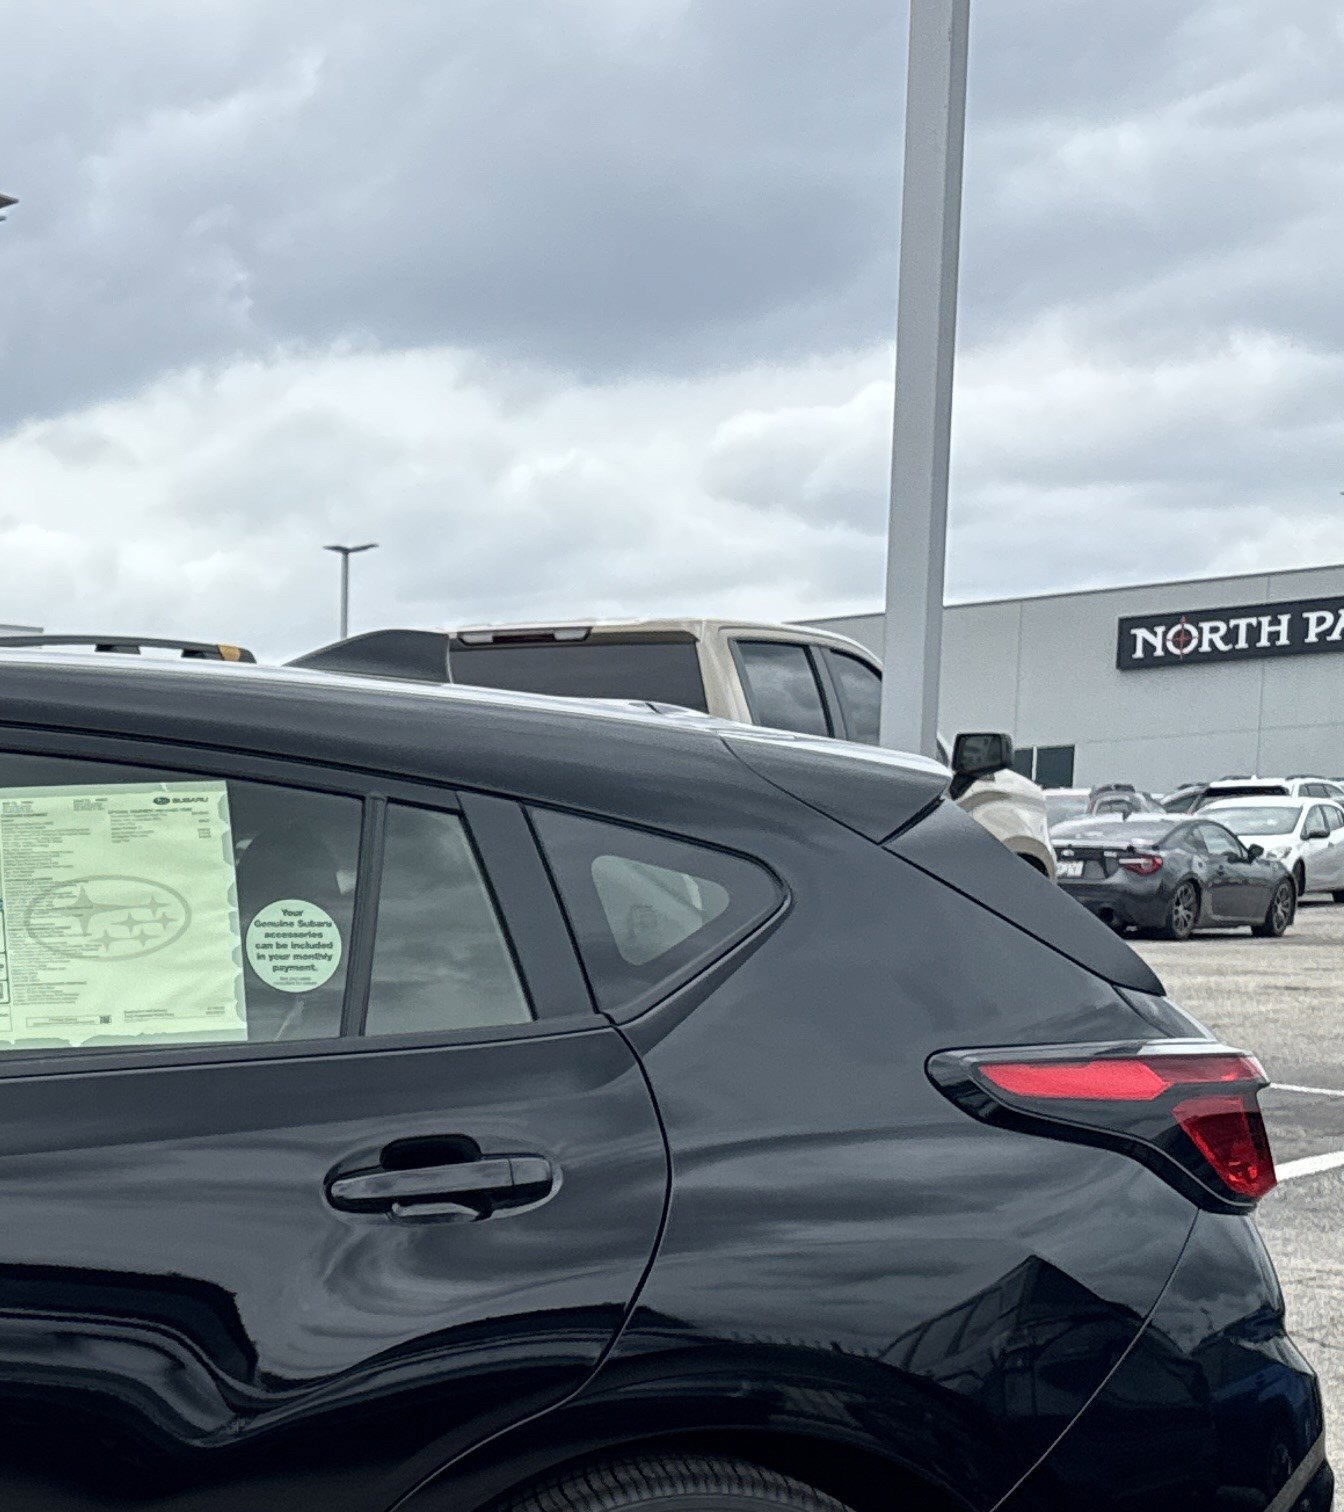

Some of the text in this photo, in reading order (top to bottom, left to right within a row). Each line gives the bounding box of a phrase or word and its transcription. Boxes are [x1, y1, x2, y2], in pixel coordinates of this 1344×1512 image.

[1130, 614, 1292, 660] NORTH
[281, 908, 304, 917] Your
[253, 919, 332, 928] Genuine Subaru
[264, 930, 324, 939] accessories
[255, 941, 333, 950] can be included
[268, 953, 290, 962] your
[293, 952, 333, 962] monthly
[272, 964, 318, 973] payment.
